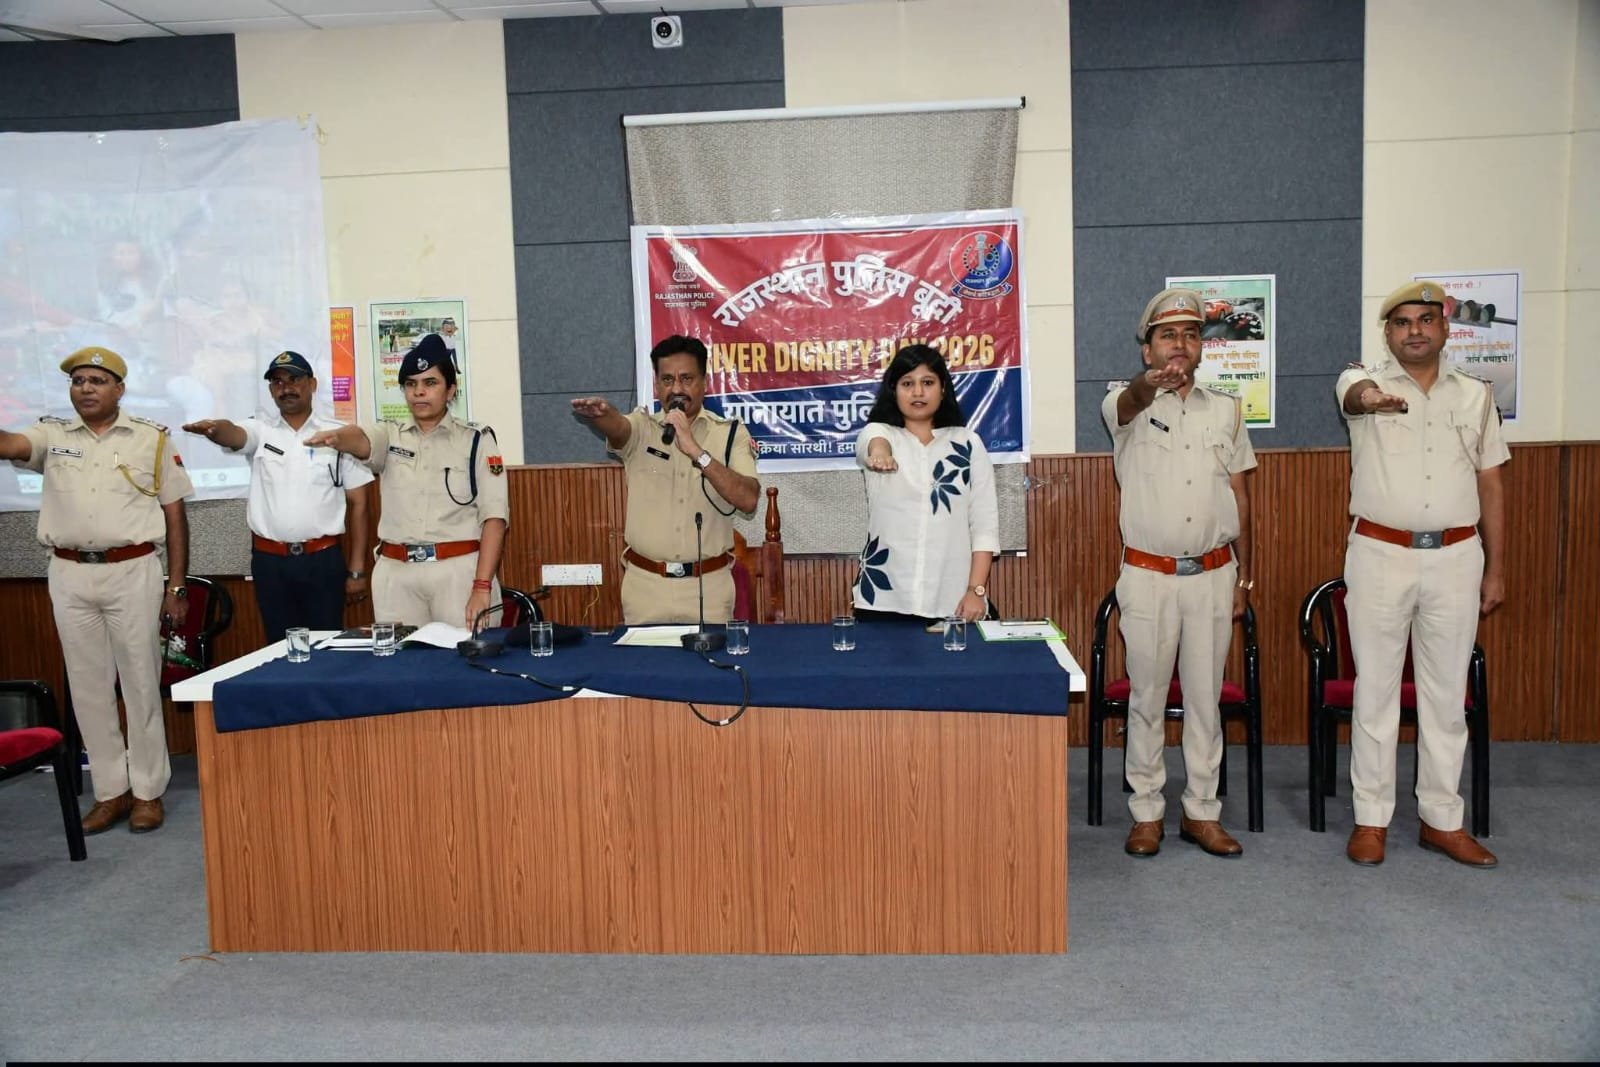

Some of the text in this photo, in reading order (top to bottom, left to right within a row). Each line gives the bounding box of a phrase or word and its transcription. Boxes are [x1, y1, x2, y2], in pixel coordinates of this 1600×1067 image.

[712, 262, 826, 327] राजस्थान
[831, 254, 915, 298] पुलिस
[706, 342, 768, 373] IVER
[774, 338, 875, 372] DIGNITY
[722, 390, 876, 431] यातायात पुलि
[757, 440, 787, 455] क्रिया
[790, 439, 832, 454] सारथी!
